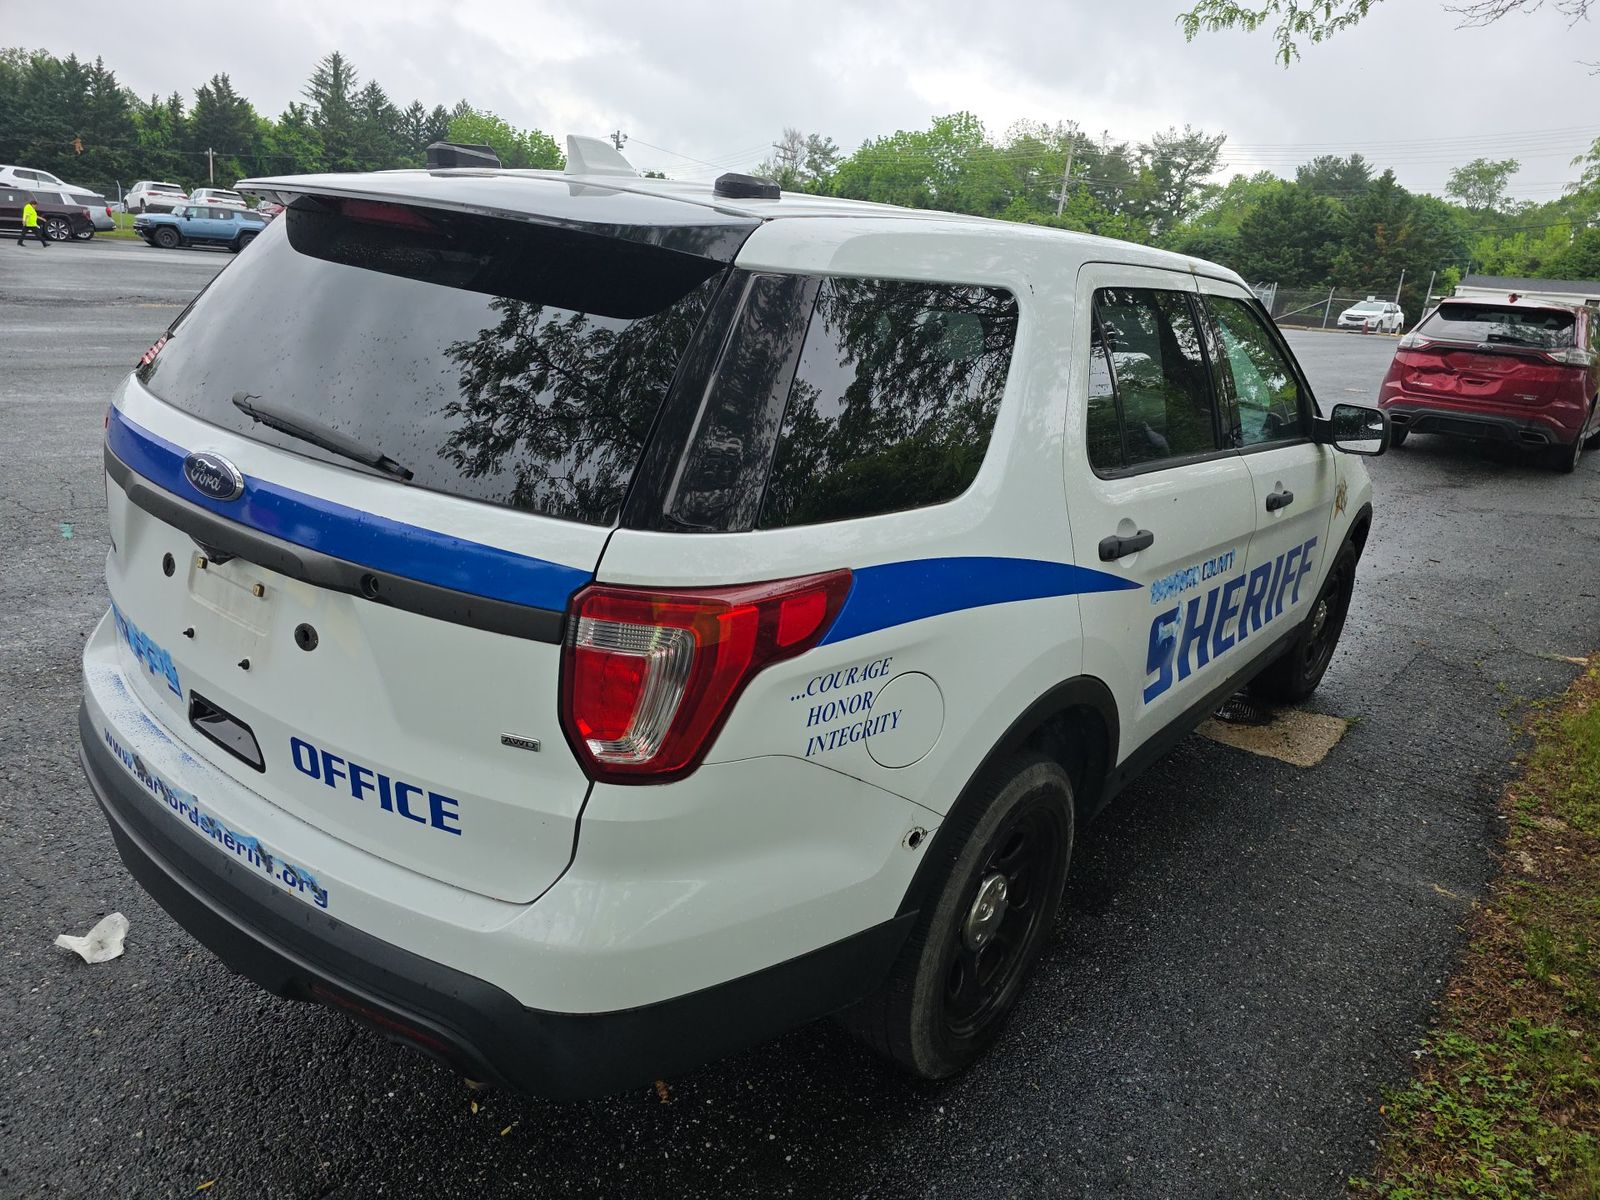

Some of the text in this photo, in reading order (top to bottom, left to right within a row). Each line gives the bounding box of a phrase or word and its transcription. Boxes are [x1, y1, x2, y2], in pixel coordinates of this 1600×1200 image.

[190, 458, 221, 491] Ford
[1143, 536, 1318, 705] SHERIFF
[806, 691, 873, 727] HONOR
[503, 736, 536, 749] AWD
[805, 709, 902, 757] INTEGRITY
[289, 736, 462, 835] OFFICE
